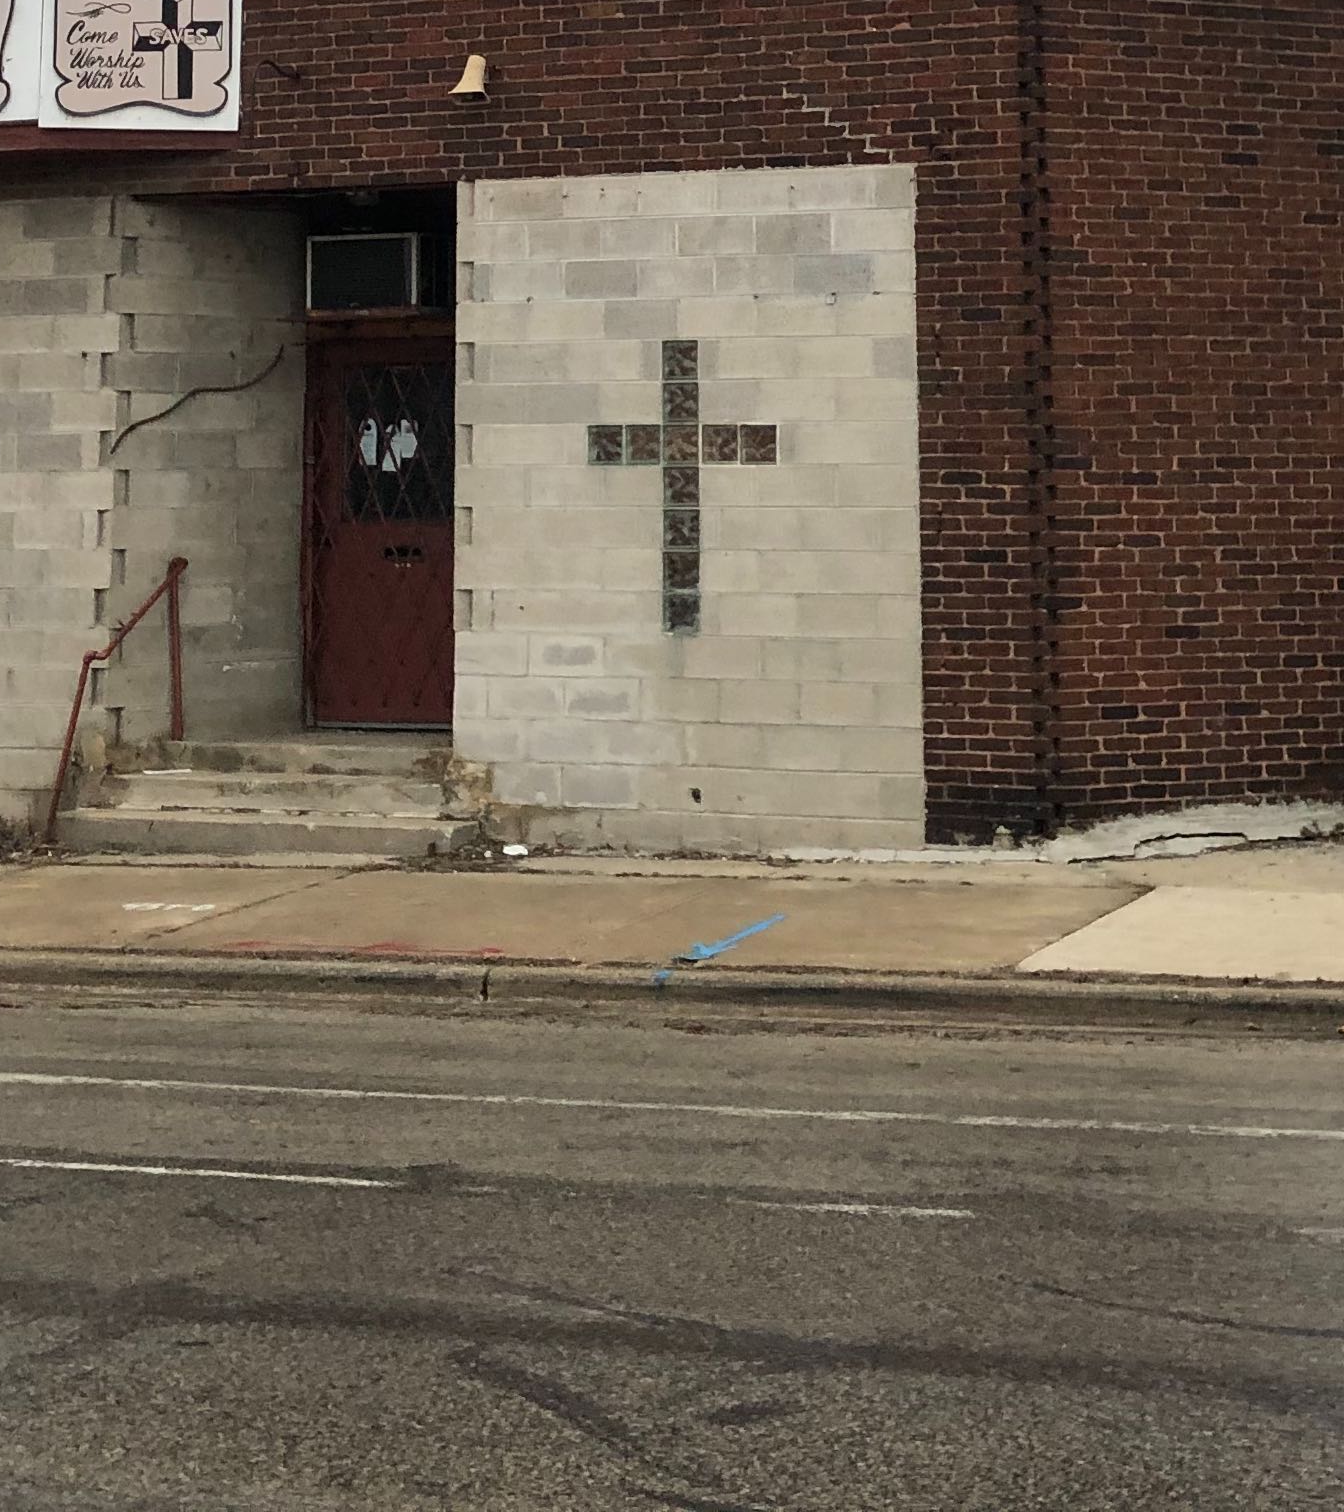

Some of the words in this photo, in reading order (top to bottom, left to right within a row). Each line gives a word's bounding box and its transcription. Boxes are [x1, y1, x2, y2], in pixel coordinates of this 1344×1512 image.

[66, 20, 118, 45] Come
[149, 27, 208, 46] SAVES
[70, 47, 145, 71] Worship
[76, 70, 113, 89] With
[119, 71, 146, 88] Us
